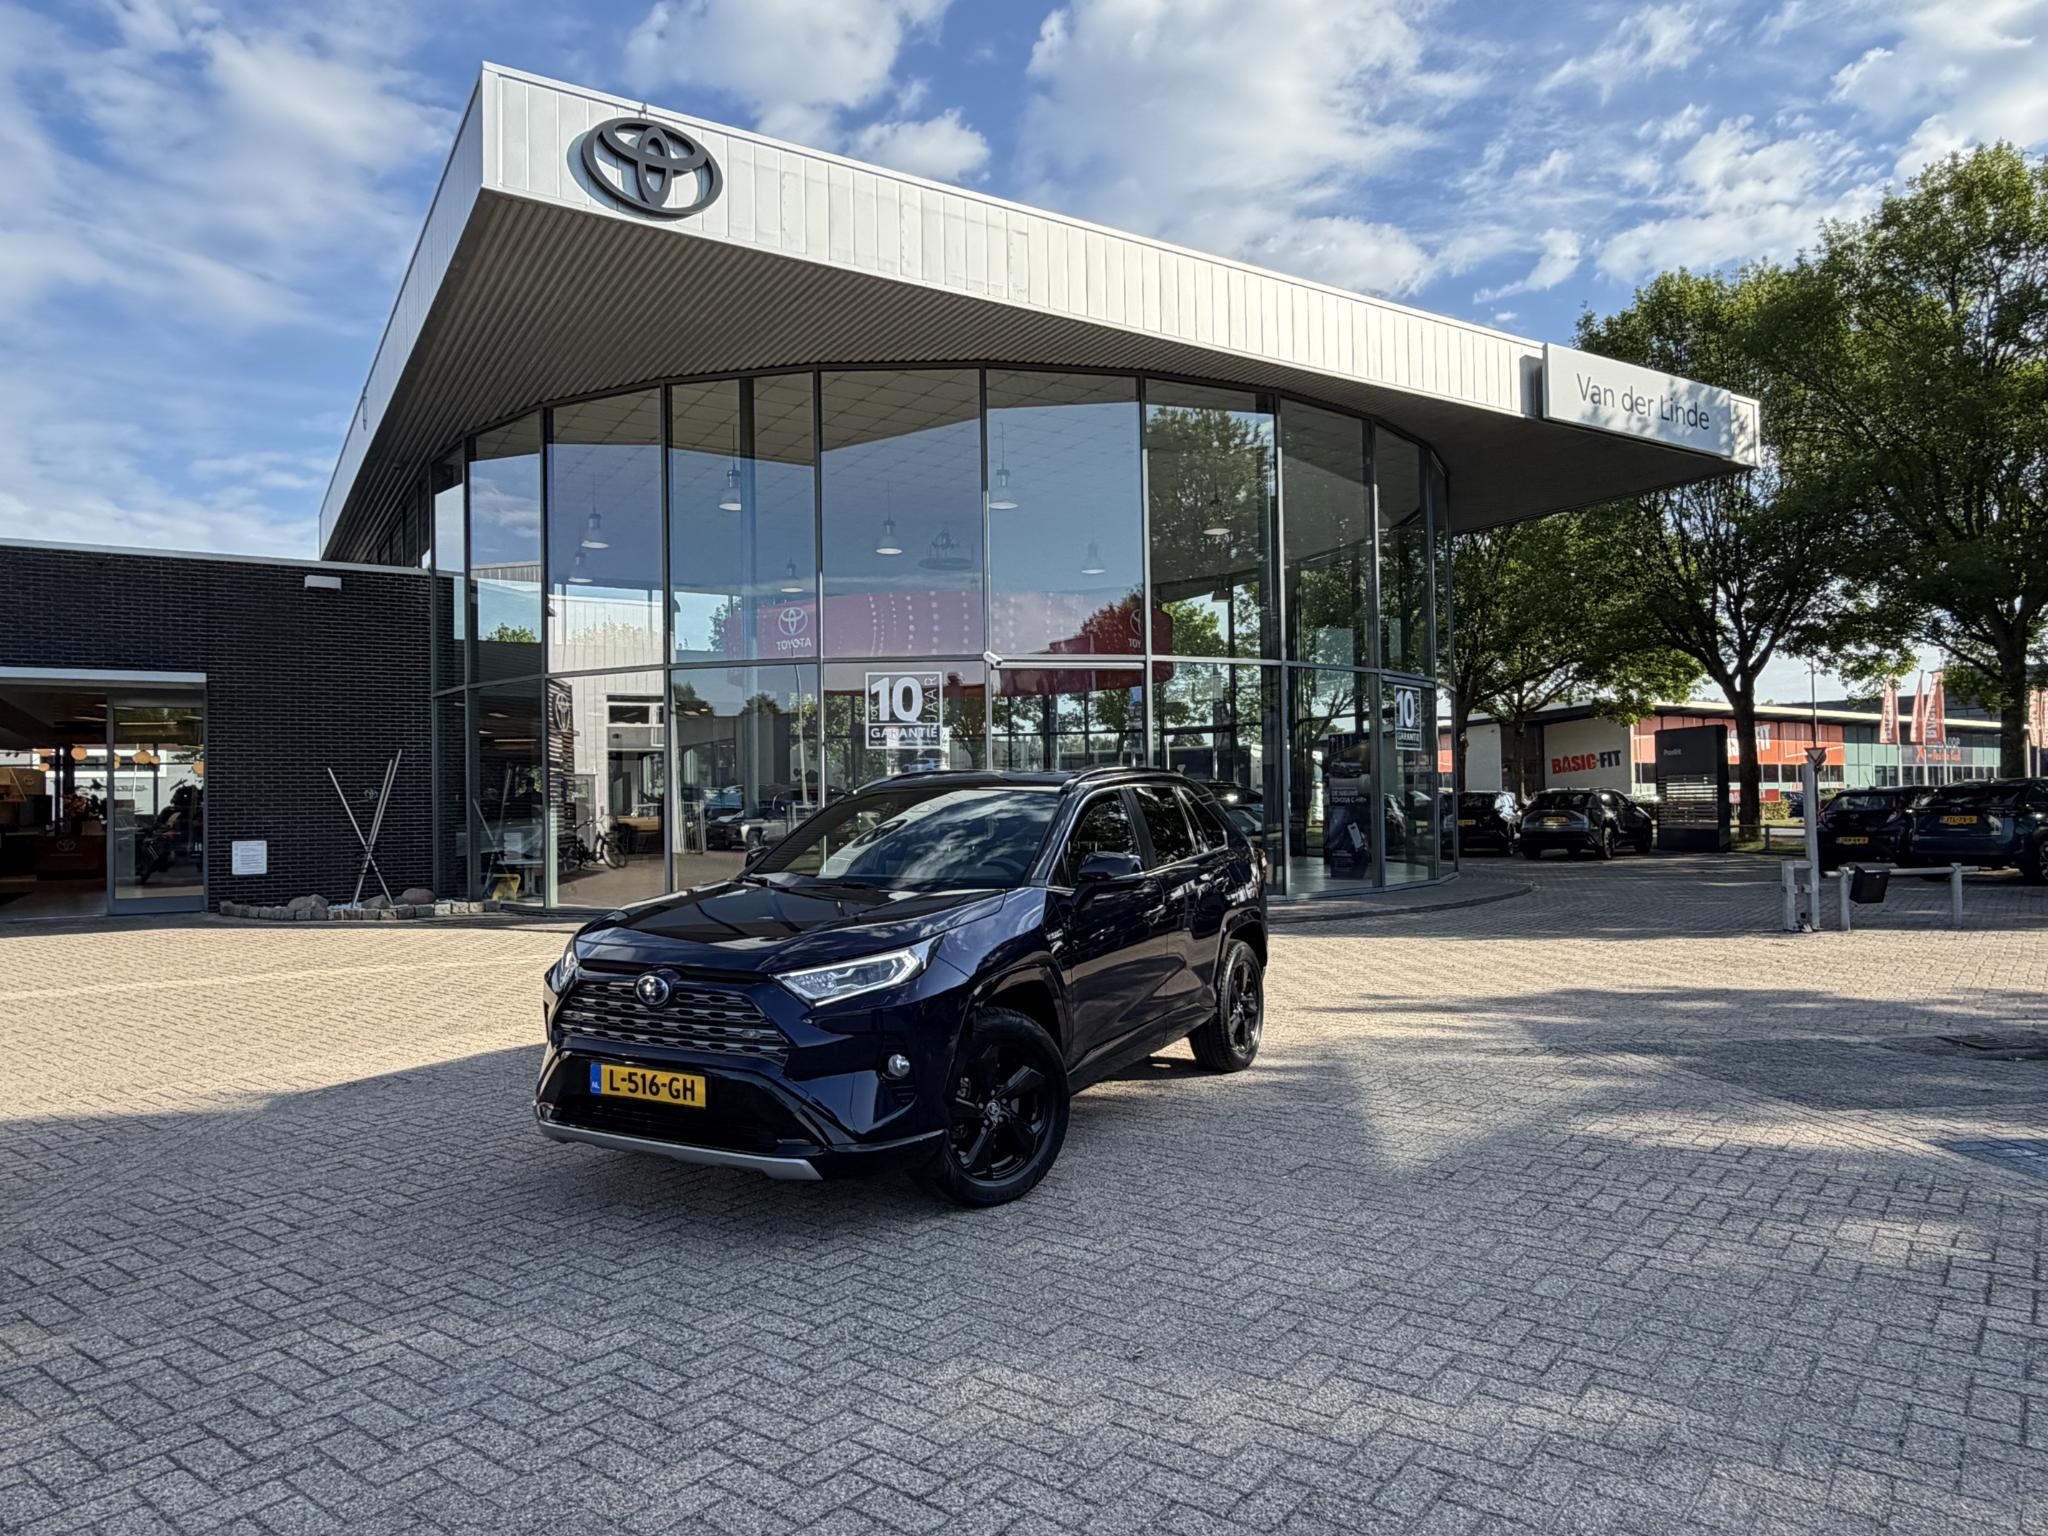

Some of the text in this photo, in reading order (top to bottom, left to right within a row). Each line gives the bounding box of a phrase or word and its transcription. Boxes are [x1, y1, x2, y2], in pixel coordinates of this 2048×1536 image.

[1576, 373, 1710, 430] Van der Linde
[776, 637, 812, 651] TOYOTA
[870, 676, 923, 722] 10
[923, 676, 937, 722] JAAR
[1396, 690, 1415, 727] 10
[870, 727, 938, 738] GARANTIE
[1551, 750, 1621, 774] BASIC-FIT
[591, 1069, 695, 1101] NL L-516-GH
